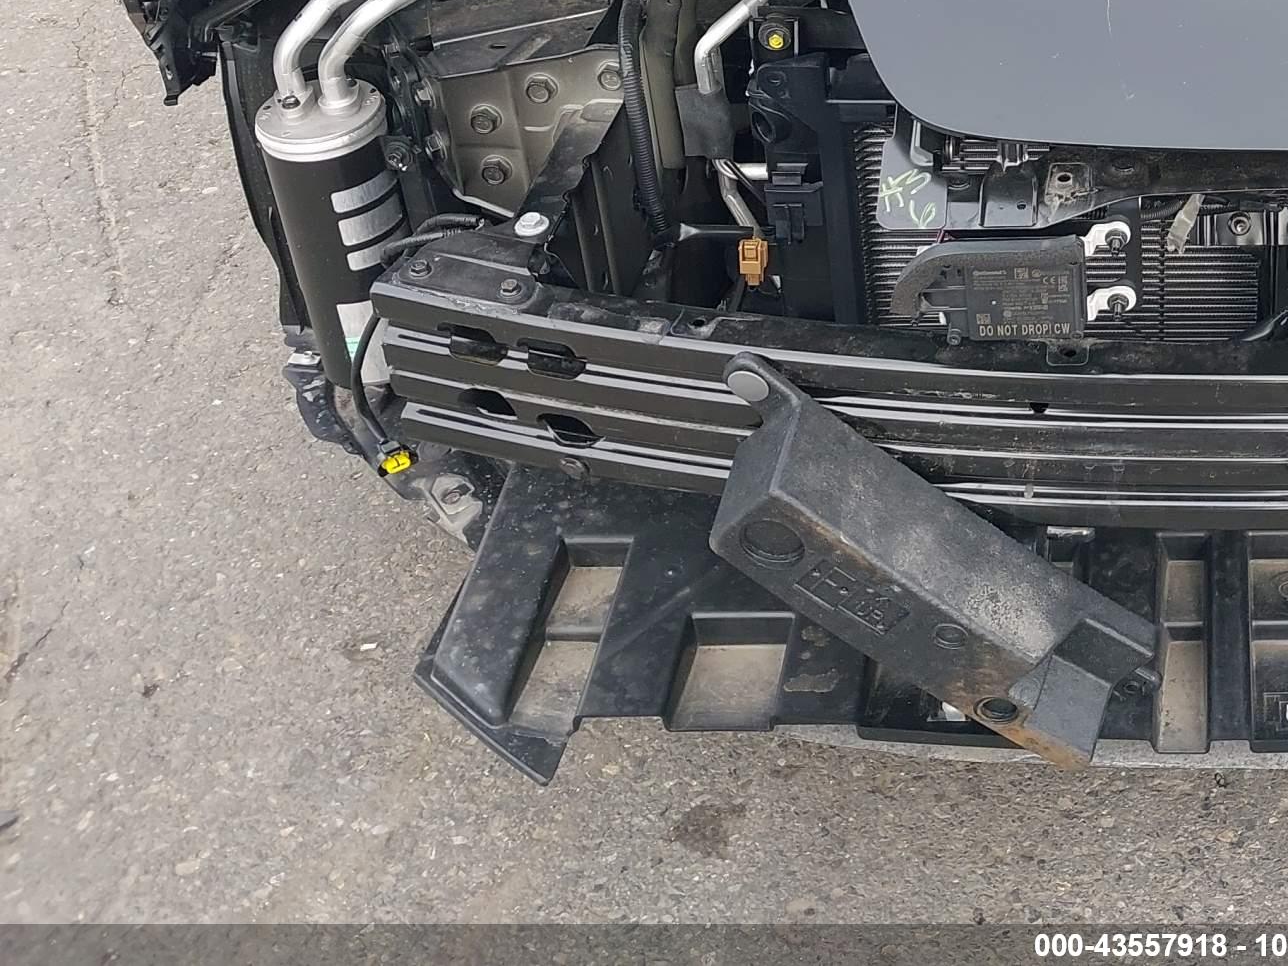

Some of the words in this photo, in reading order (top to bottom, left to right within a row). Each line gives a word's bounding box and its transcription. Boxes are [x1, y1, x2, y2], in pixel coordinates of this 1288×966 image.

[979, 325, 994, 336] DO
[997, 324, 1018, 336] NOT
[1054, 322, 1070, 334] CW
